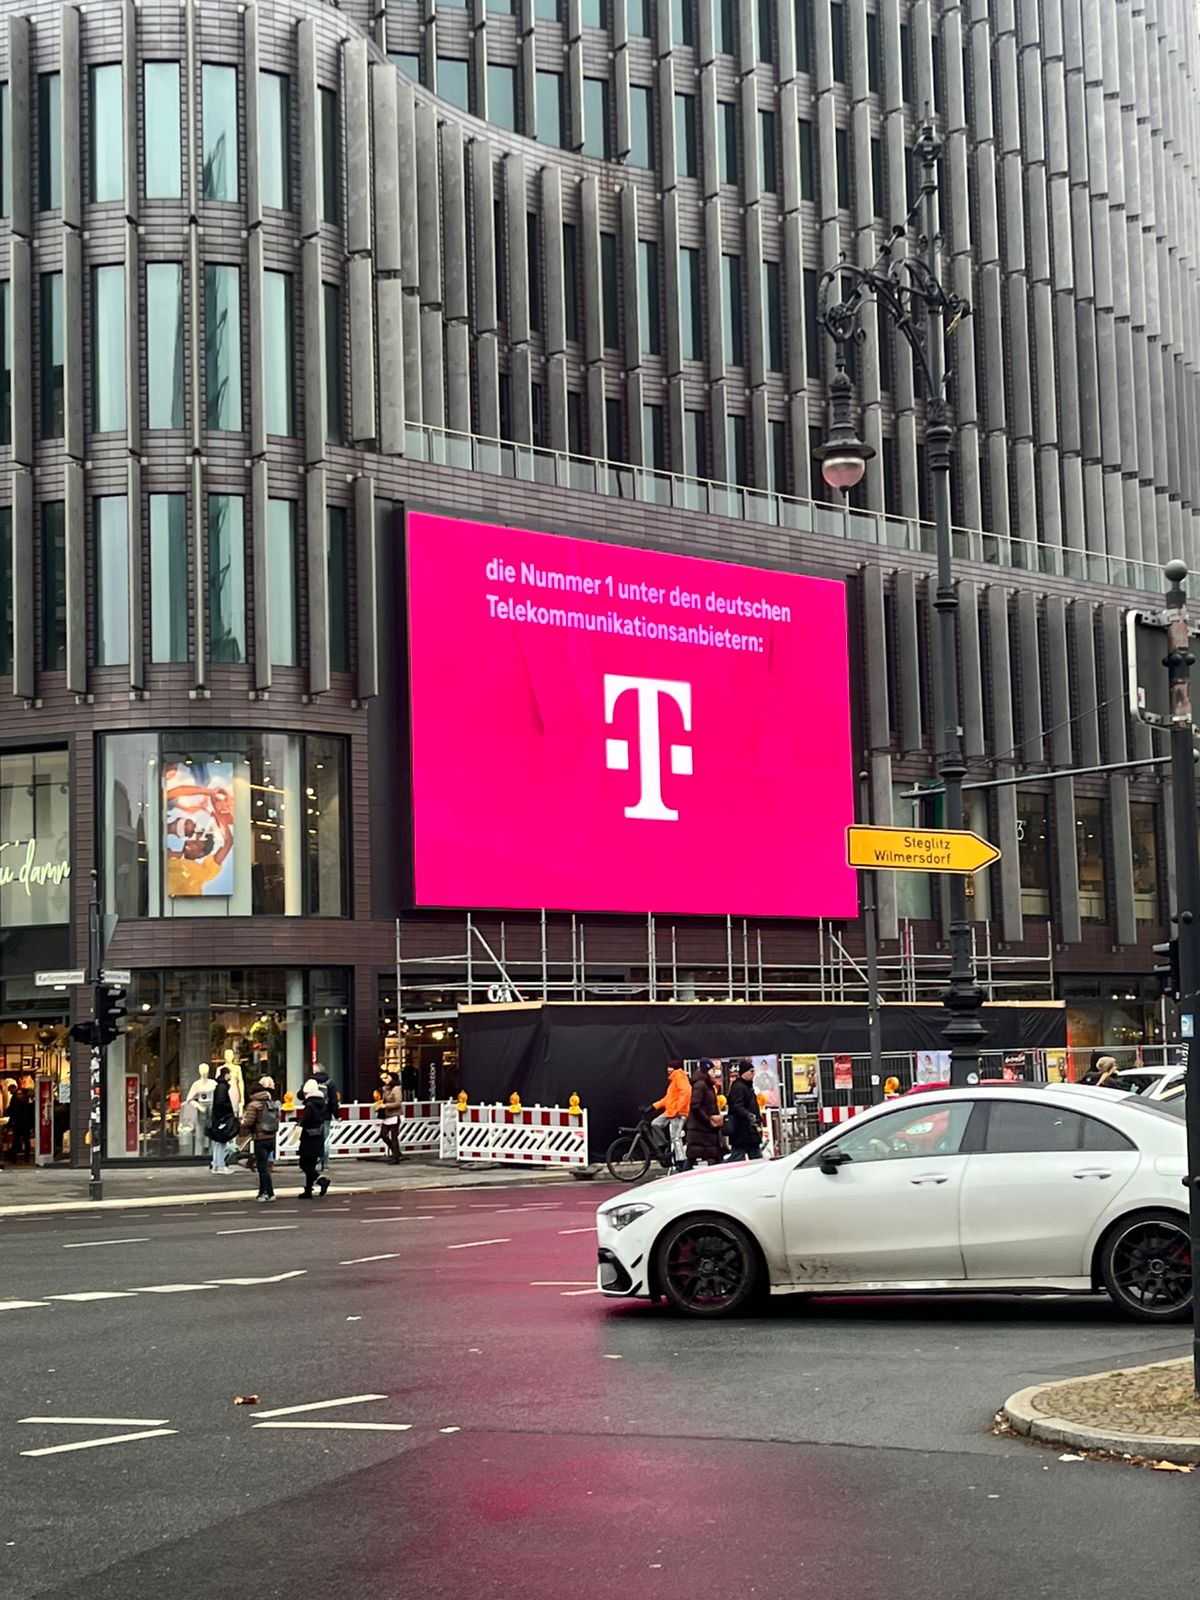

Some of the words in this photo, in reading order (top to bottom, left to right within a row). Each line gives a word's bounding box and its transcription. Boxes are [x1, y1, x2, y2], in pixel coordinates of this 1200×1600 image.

[486, 558, 516, 583] die
[521, 562, 602, 596] Nummer
[605, 575, 614, 596] 1
[618, 580, 666, 605] unter
[669, 586, 701, 610] den
[705, 592, 792, 622] deutschen
[486, 594, 764, 652] Telekommunikationsanbietern:
[874, 849, 951, 865] Wilmersdorf
[904, 836, 951, 851] Steglitz
